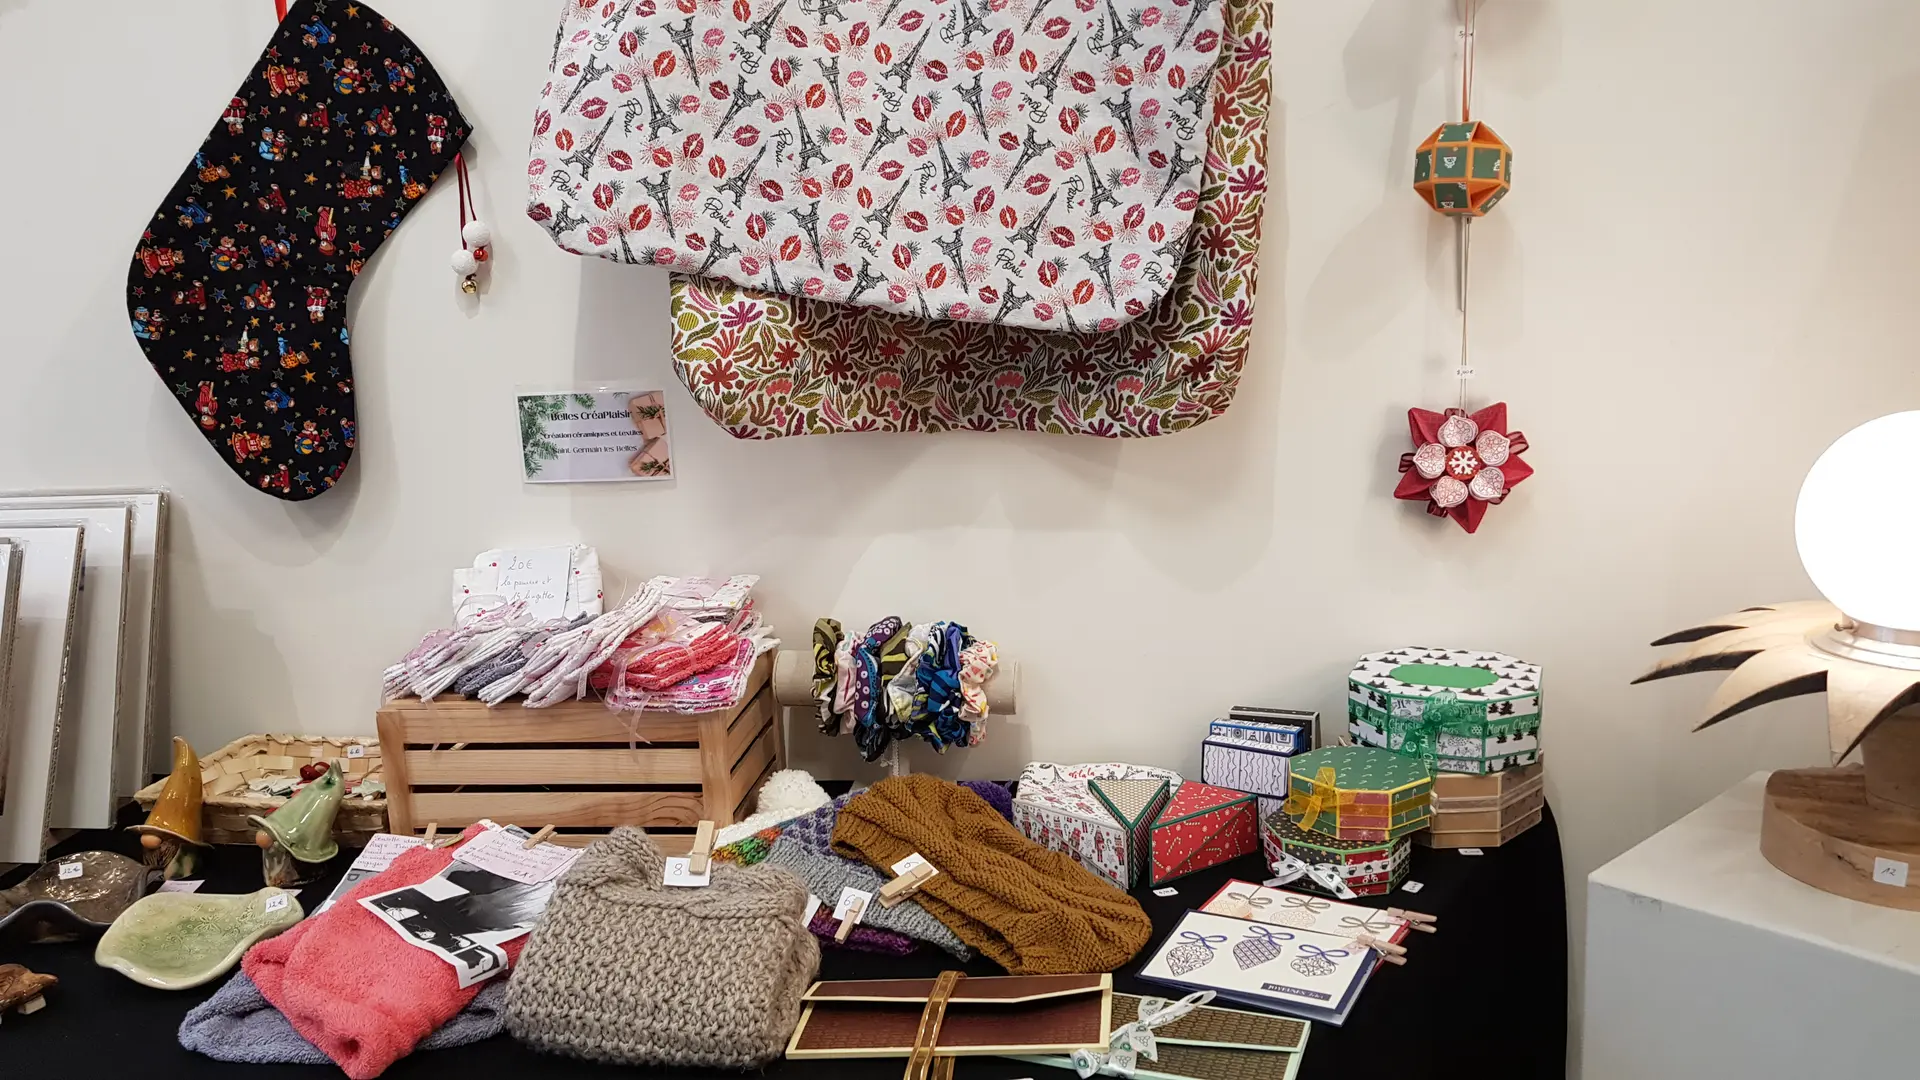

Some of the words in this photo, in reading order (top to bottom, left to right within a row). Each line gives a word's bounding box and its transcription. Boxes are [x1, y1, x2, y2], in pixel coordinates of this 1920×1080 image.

[549, 169, 579, 201] Paris
[914, 160, 937, 199] Paris
[1061, 174, 1085, 214] Paris
[702, 197, 731, 229] Paris
[850, 226, 879, 258] Paris
[994, 248, 1024, 279] Paris
[1140, 260, 1168, 290] Paris
[551, 412, 579, 421] Belles
[580, 409, 632, 420] CréaPlaisir
[543, 431, 571, 439] Création
[572, 431, 609, 439] céramiques
[508, 555, 533, 571] 20€
[1487, 723, 1510, 736] Merry
[673, 863, 683, 876] 8
[843, 893, 856, 906] 6
